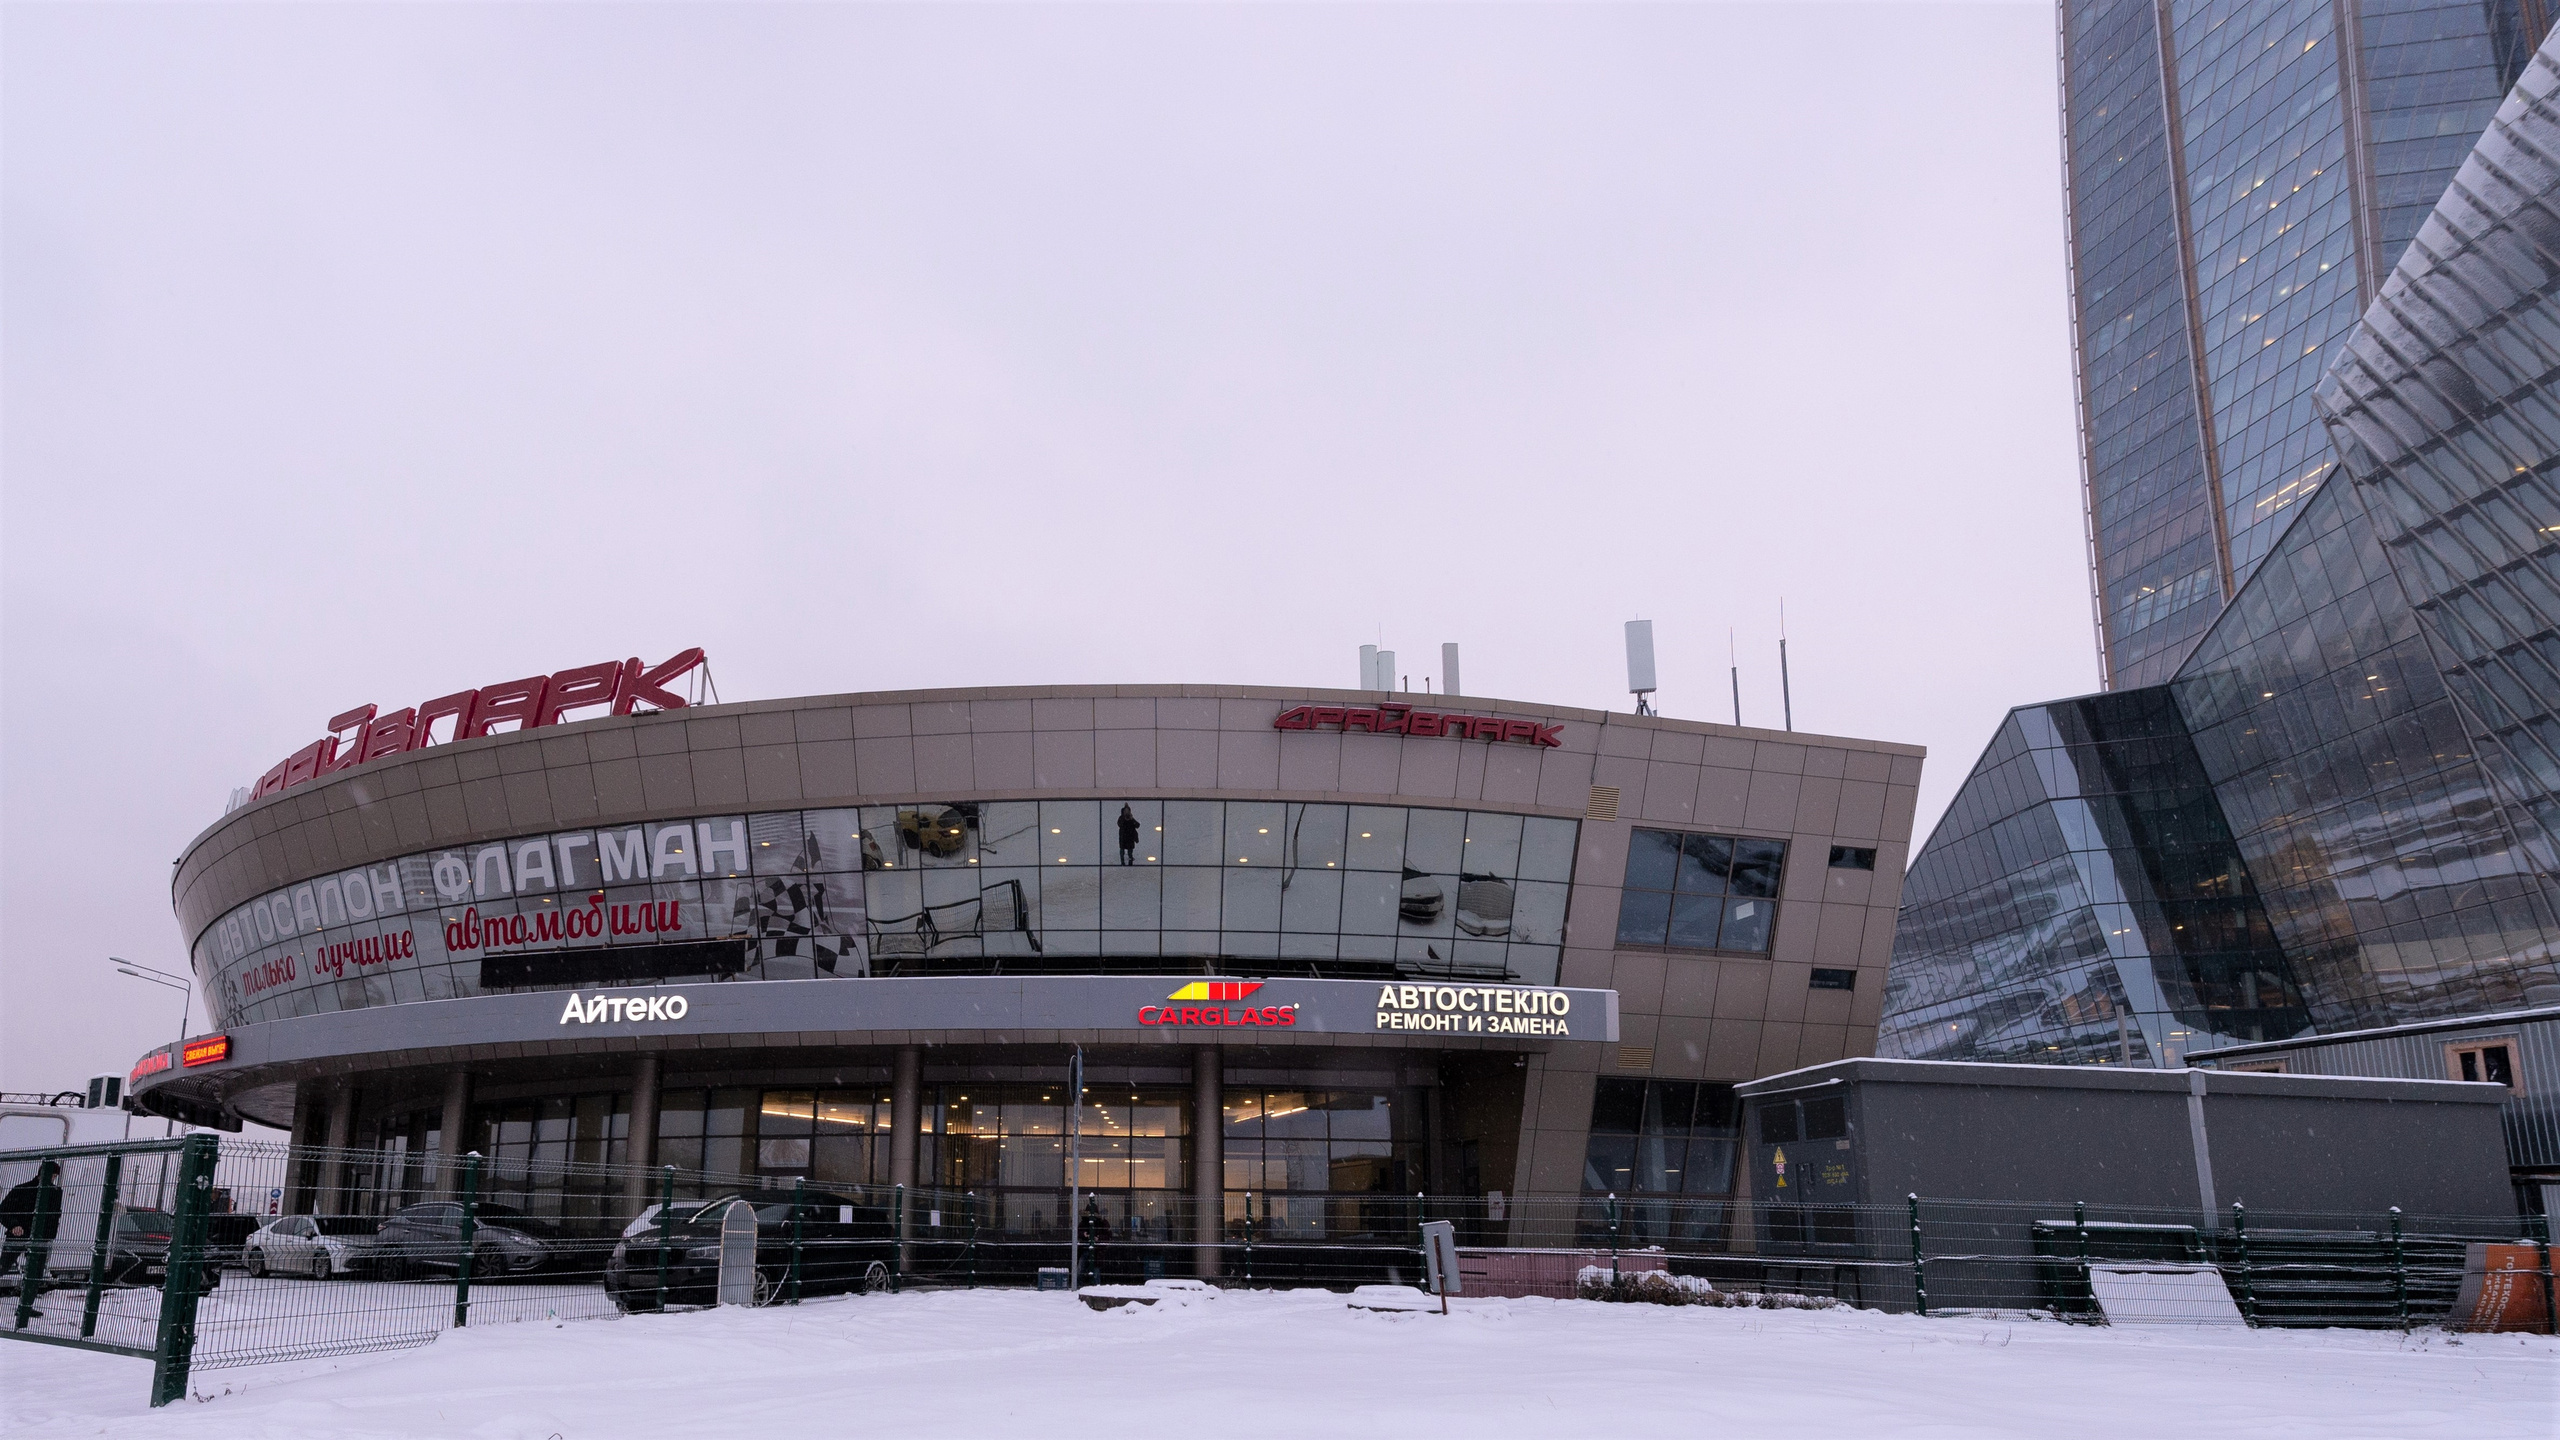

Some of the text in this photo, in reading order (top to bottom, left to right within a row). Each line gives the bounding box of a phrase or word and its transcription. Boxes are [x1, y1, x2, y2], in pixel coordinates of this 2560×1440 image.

[1274, 702, 1564, 747] ДРАЙВПАРК
[218, 821, 748, 961] АВТОСАЛОН ФЛАГМАН
[242, 895, 682, 996] только лучшие автомобили
[560, 992, 688, 1024] Айтеко
[1138, 1005, 1296, 1026] CARGLASS
[1378, 985, 1570, 1016] АВТОСТЕКЛО
[1376, 1012, 1570, 1036] РЕМОНТ И ЗАМЕНА
